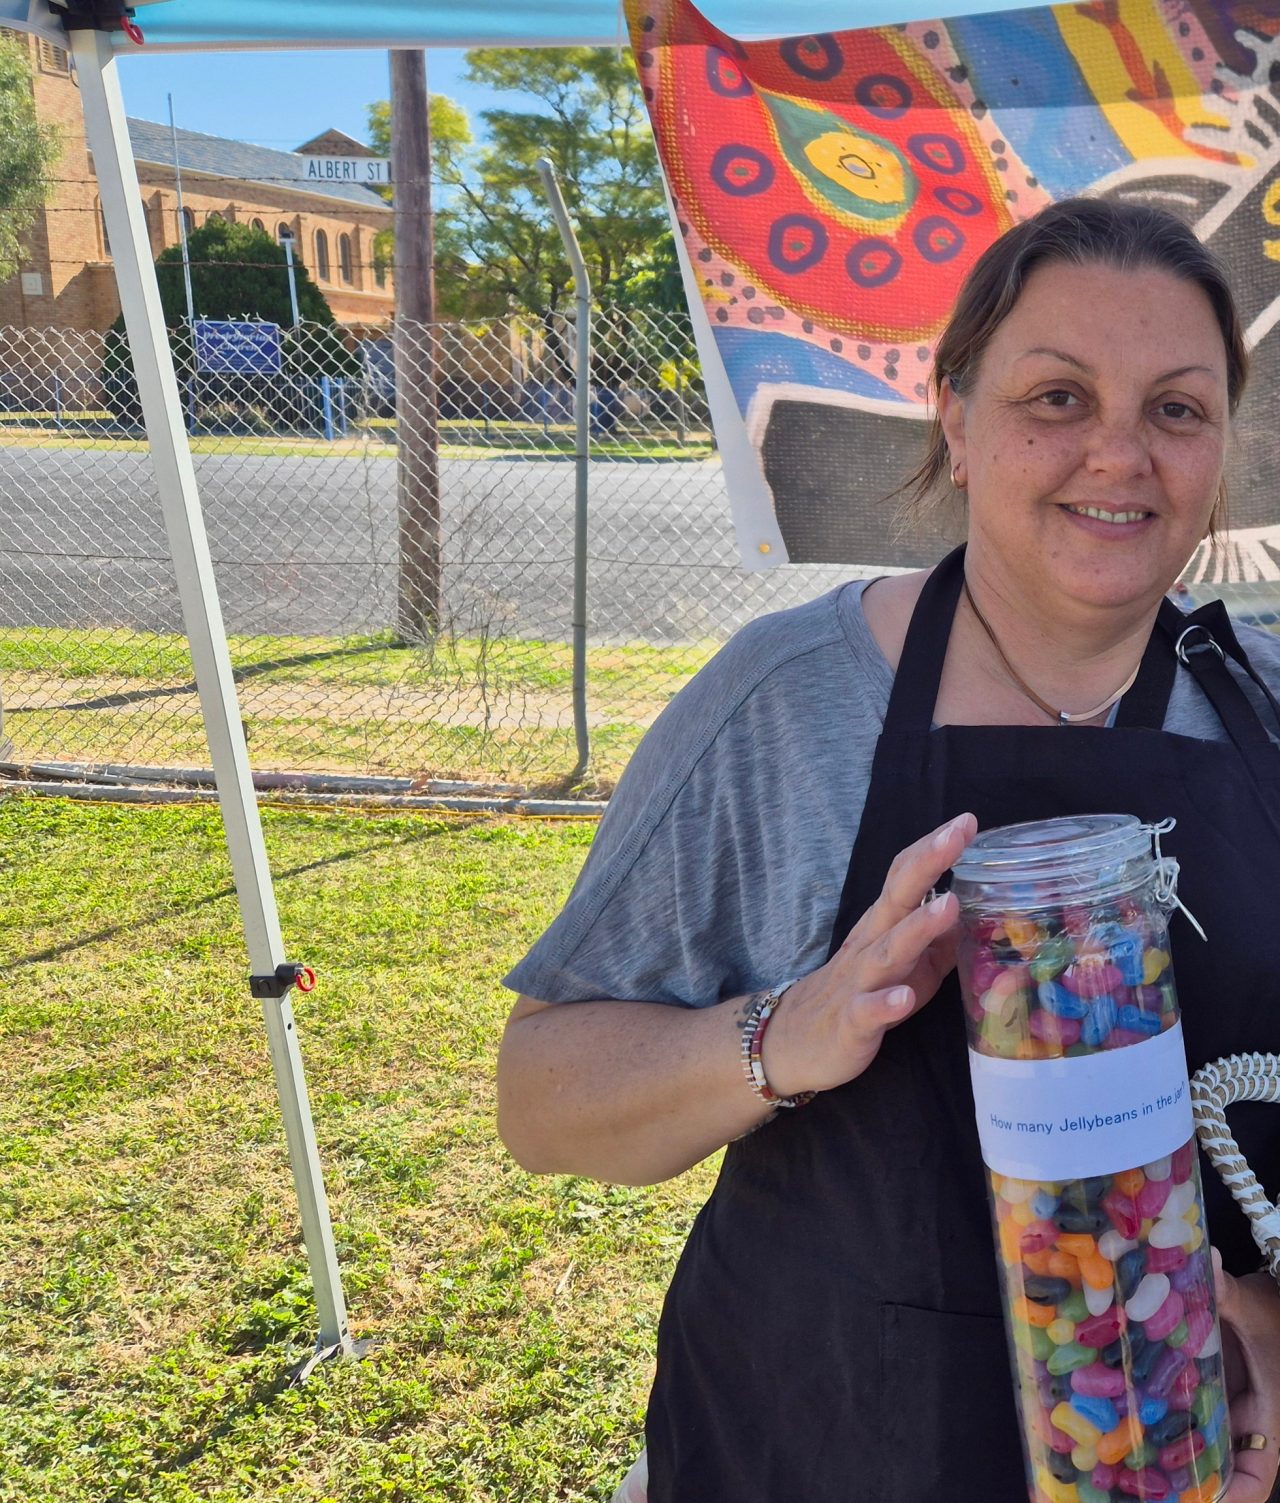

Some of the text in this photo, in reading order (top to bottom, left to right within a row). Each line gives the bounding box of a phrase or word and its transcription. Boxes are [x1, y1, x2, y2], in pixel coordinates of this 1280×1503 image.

[308, 159, 381, 180] ALBERT ST
[990, 1113, 1012, 1131] How
[1016, 1119, 1053, 1135] many
[1059, 1109, 1138, 1133] Jellybeans
[1142, 1102, 1154, 1115] in
[1156, 1094, 1173, 1111] the
